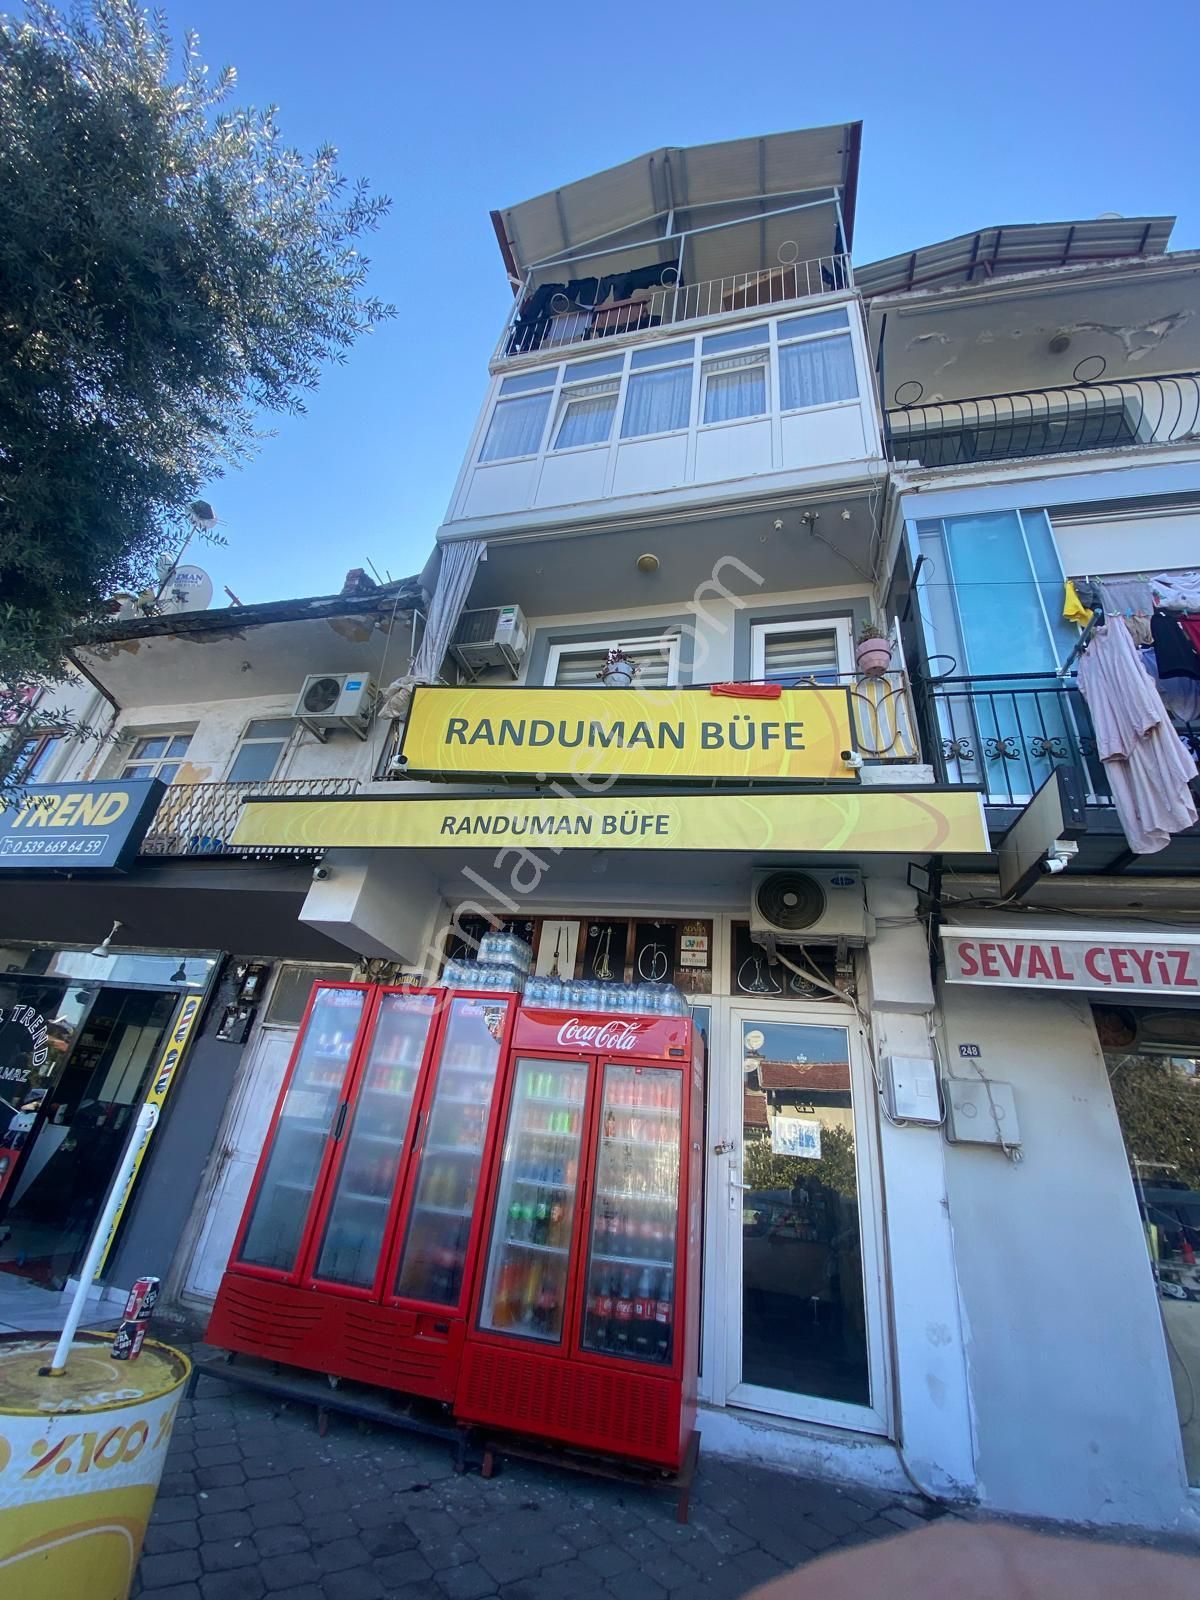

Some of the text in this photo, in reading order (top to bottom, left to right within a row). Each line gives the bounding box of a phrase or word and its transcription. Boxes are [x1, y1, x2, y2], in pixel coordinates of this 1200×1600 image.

[445, 714, 806, 751] RANDUMAN BÜFE
[11, 791, 130, 828] TREND
[440, 810, 670, 836] RANDUMAN BÜFE
[22, 840, 45, 853] 539
[45, 840, 67, 853] 669
[68, 840, 84, 853] 64
[84, 840, 102, 853] 59
[957, 942, 1075, 981] SEVAL
[11, 1004, 49, 1067] TREND
[961, 1046, 979, 1057] 248
